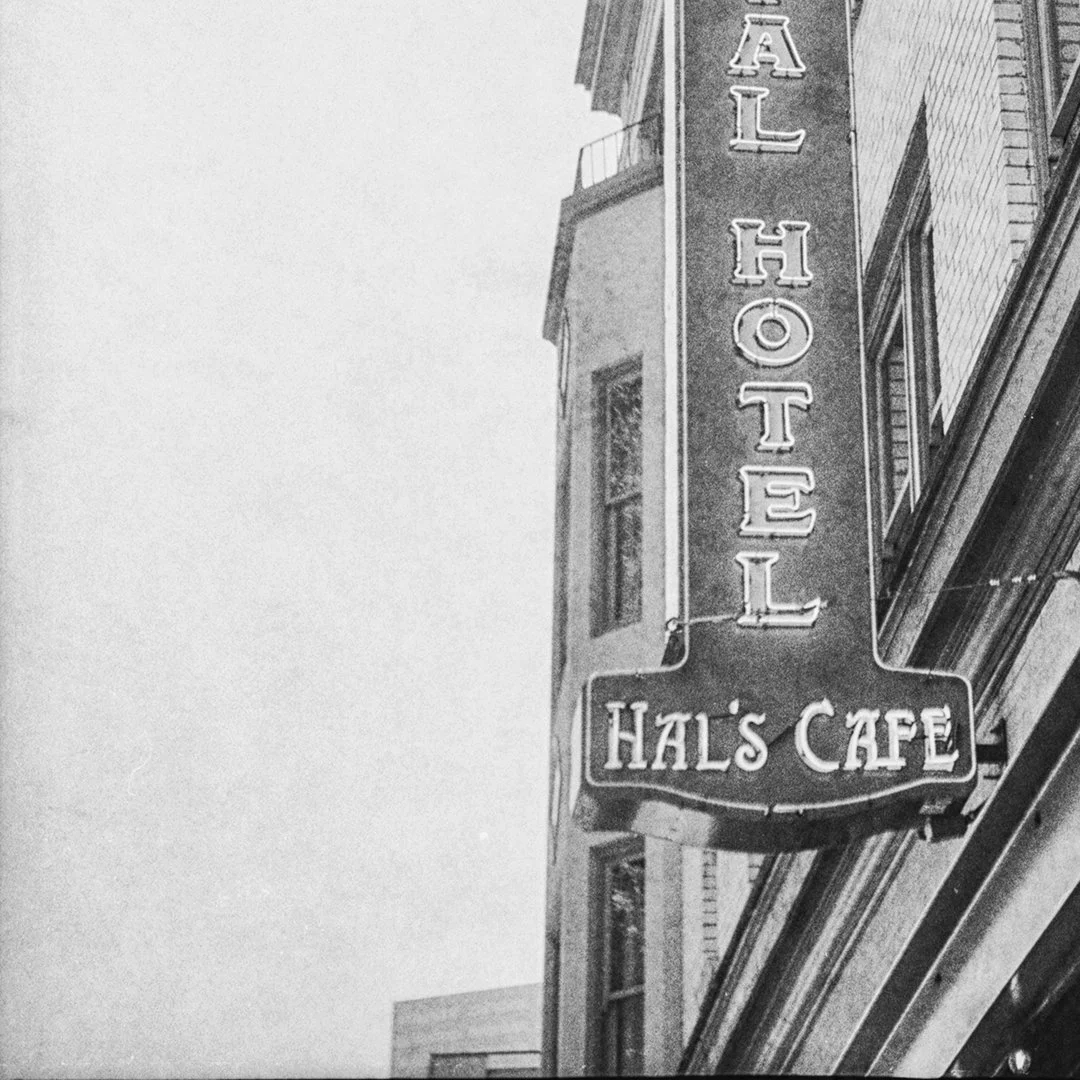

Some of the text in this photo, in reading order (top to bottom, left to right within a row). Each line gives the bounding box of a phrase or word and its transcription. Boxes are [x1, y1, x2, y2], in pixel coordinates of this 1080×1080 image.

[731, 218, 822, 627] HOTEL
[604, 698, 960, 773] HAL'S CAFE
